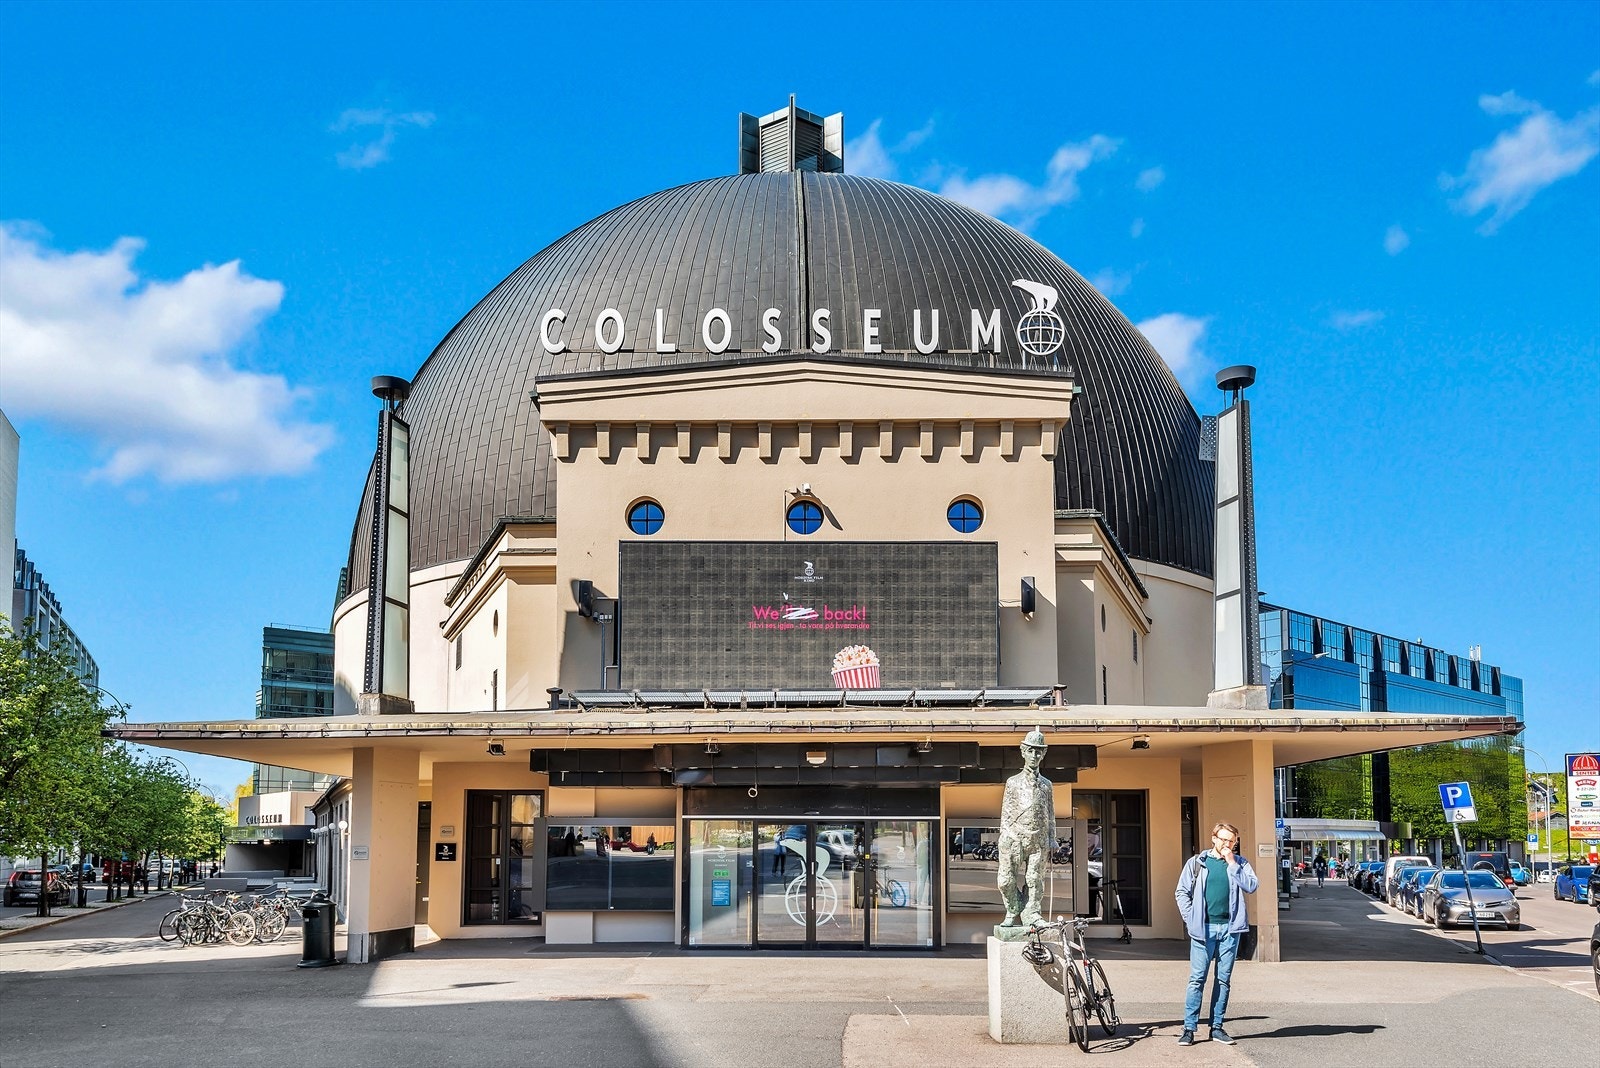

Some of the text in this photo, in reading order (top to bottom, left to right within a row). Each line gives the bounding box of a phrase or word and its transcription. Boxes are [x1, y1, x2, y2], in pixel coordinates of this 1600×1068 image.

[540, 308, 1000, 353] COLOSSEUM
[824, 604, 866, 620] back!
[1446, 786, 1462, 806] P
[245, 814, 282, 824] COLOSSEUM
